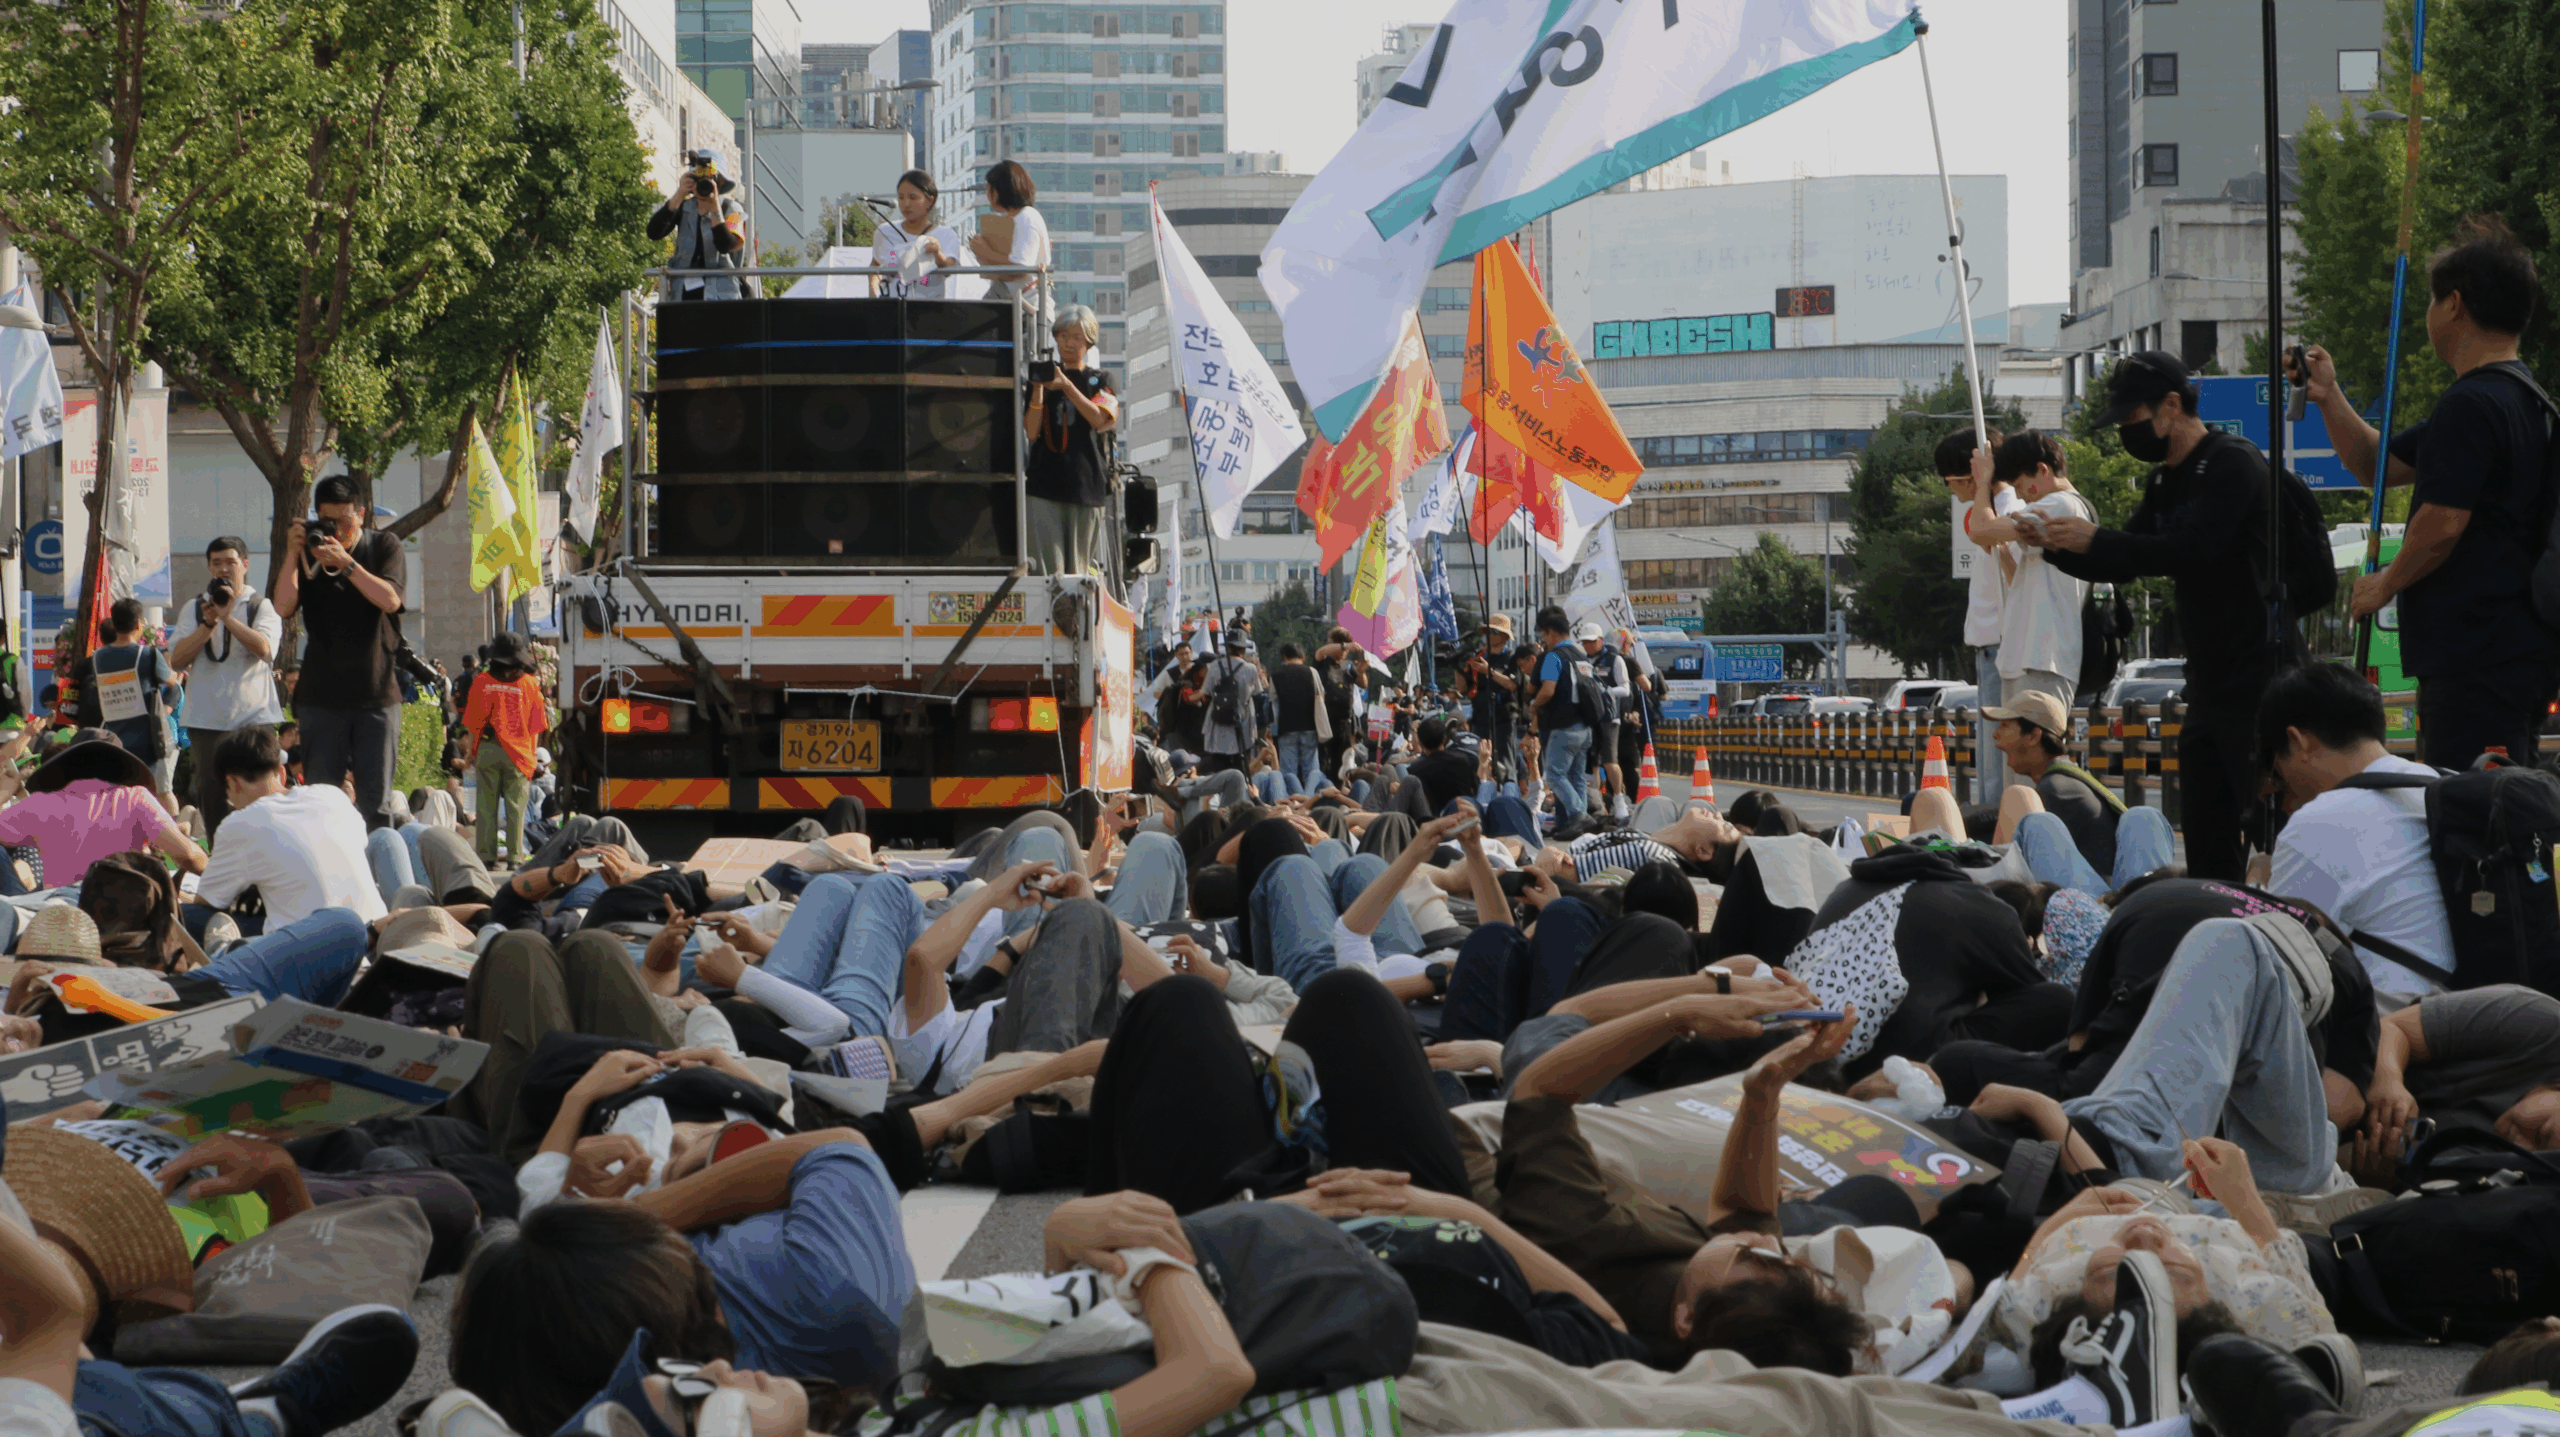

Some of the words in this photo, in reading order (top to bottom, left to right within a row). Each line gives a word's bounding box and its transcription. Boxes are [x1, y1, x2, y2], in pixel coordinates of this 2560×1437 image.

[1677, 658, 1698, 670] 151
[833, 723, 856, 737] 96
[806, 739, 875, 765] 6204
